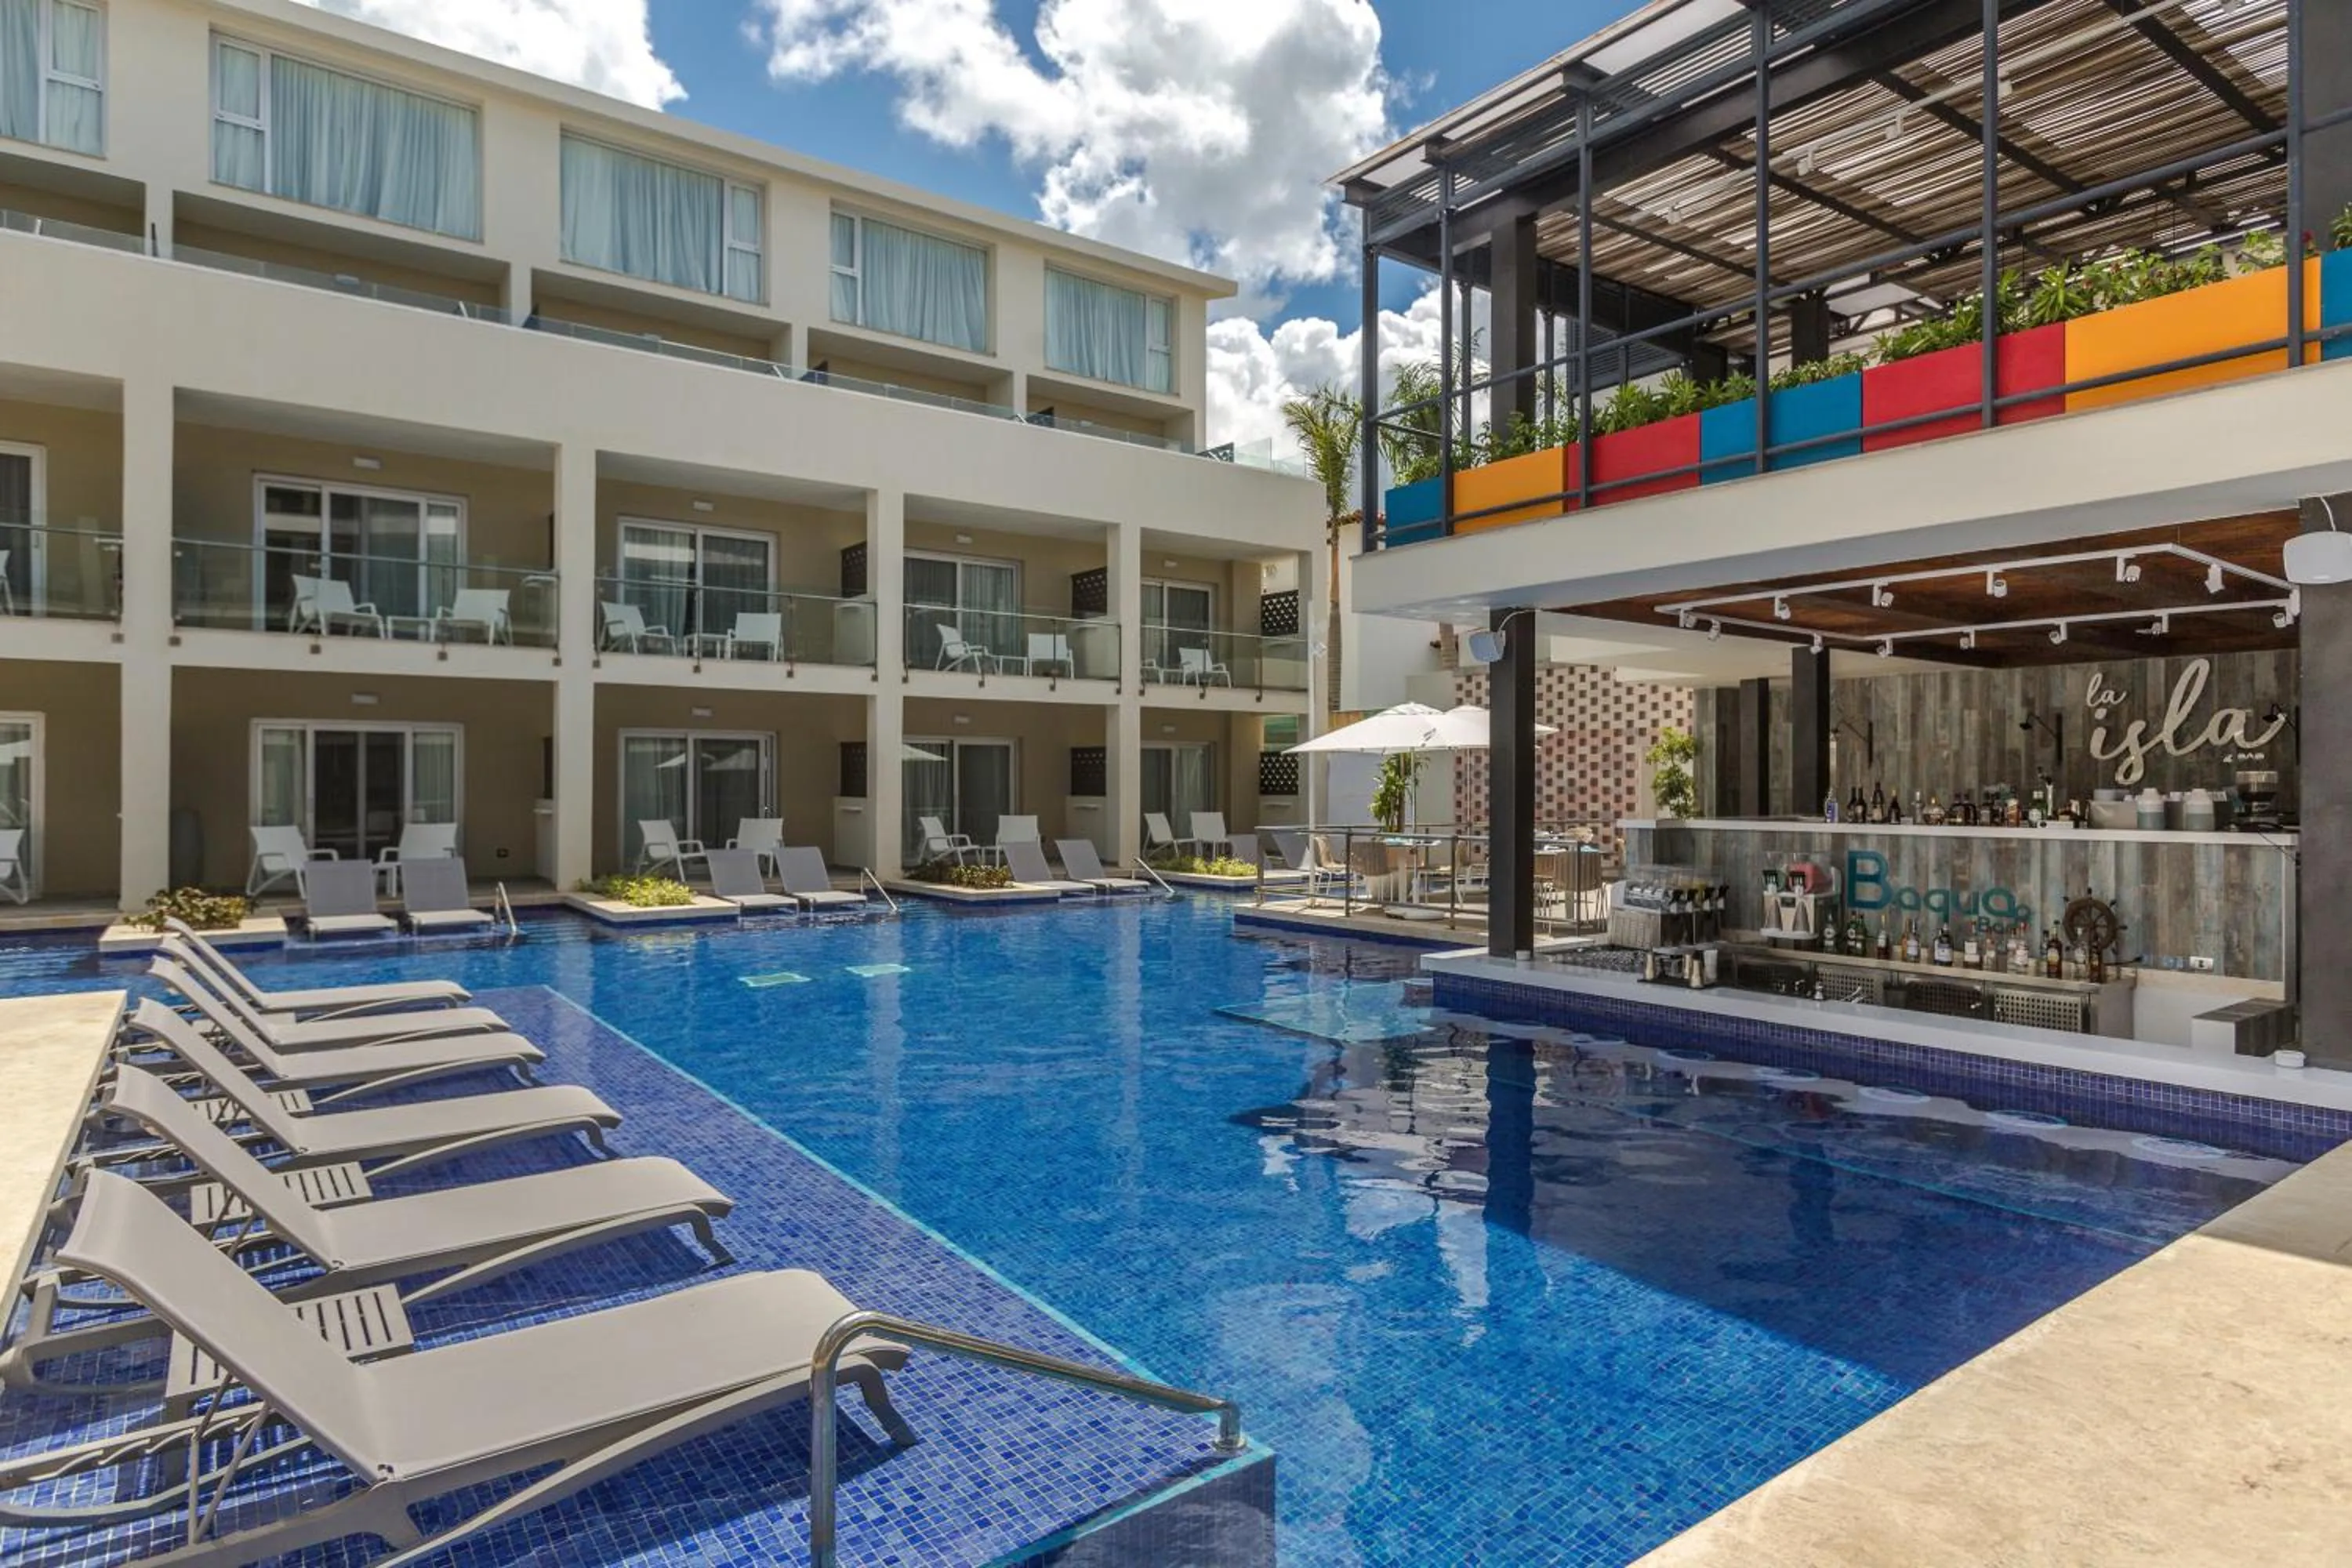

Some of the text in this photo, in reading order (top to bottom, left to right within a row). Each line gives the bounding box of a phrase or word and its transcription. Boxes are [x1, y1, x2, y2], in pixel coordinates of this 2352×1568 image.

[2086, 673, 2127, 706] la
[2089, 658, 2286, 785] isla
[1847, 850, 2016, 924] Baqua
